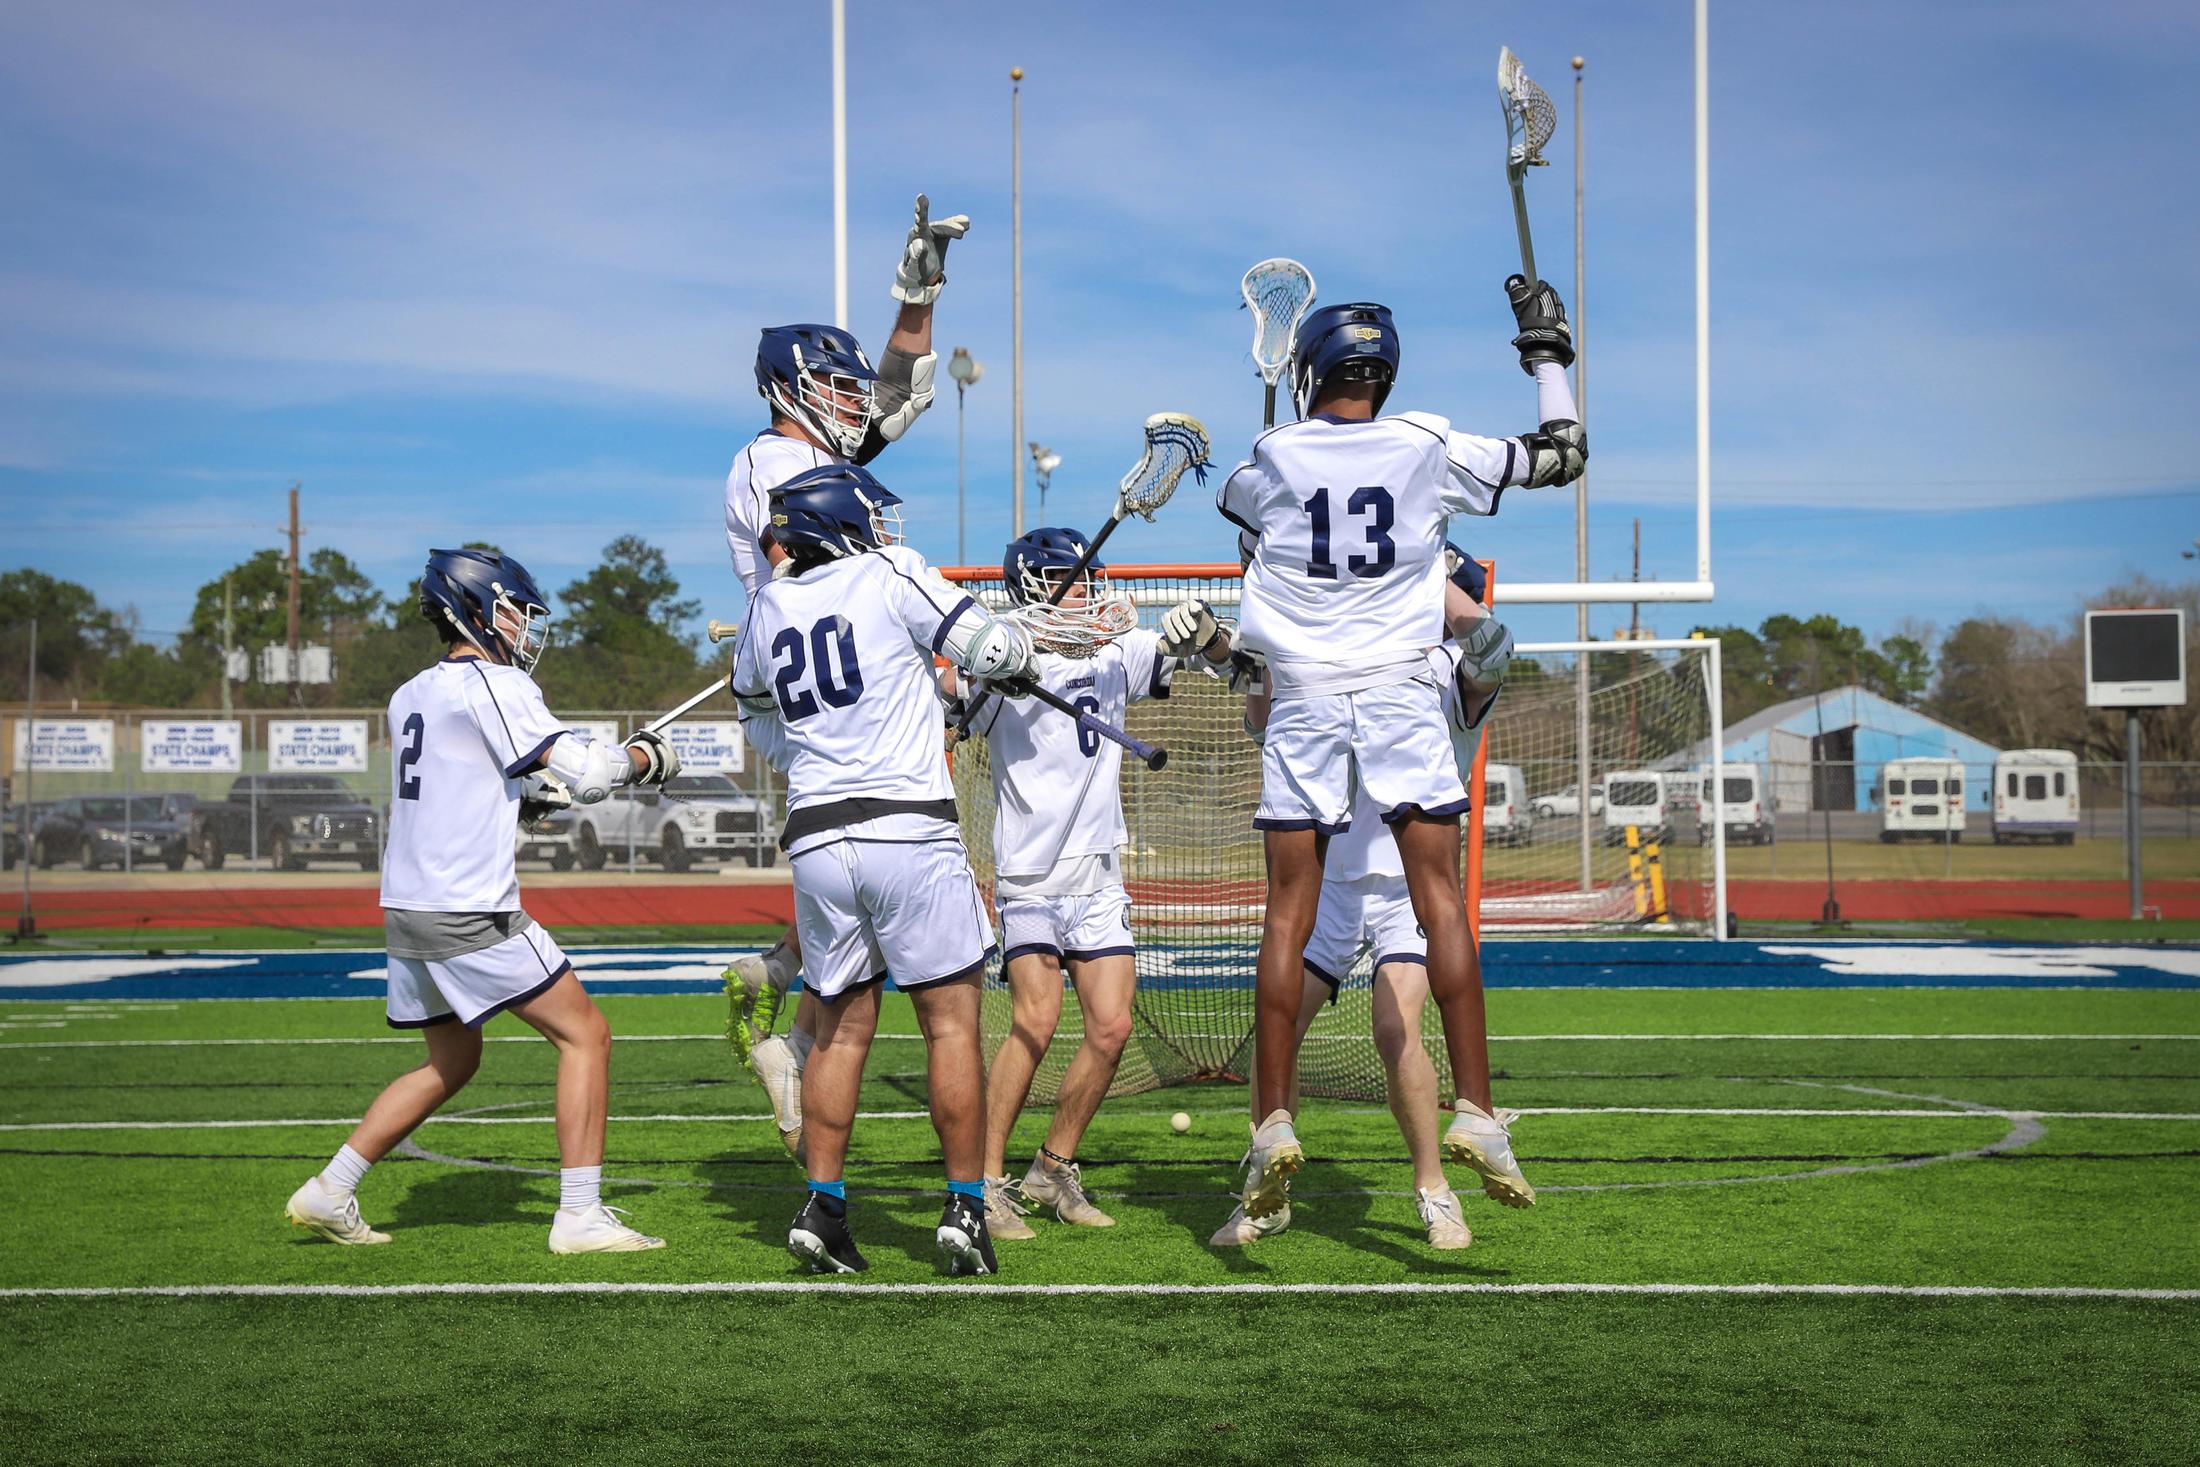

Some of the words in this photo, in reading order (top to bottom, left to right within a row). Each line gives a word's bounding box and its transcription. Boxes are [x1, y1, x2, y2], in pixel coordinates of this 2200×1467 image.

[1304, 486, 1395, 580] 13
[771, 613, 864, 723] 20
[152, 744, 181, 757] STATE
[185, 744, 231, 757] CHAMPS
[279, 744, 307, 757] STATE
[312, 744, 356, 757] CHAMPS
[399, 713, 425, 801] 2
[688, 745, 734, 758] CHAMPS
[1073, 696, 1101, 758] 6
